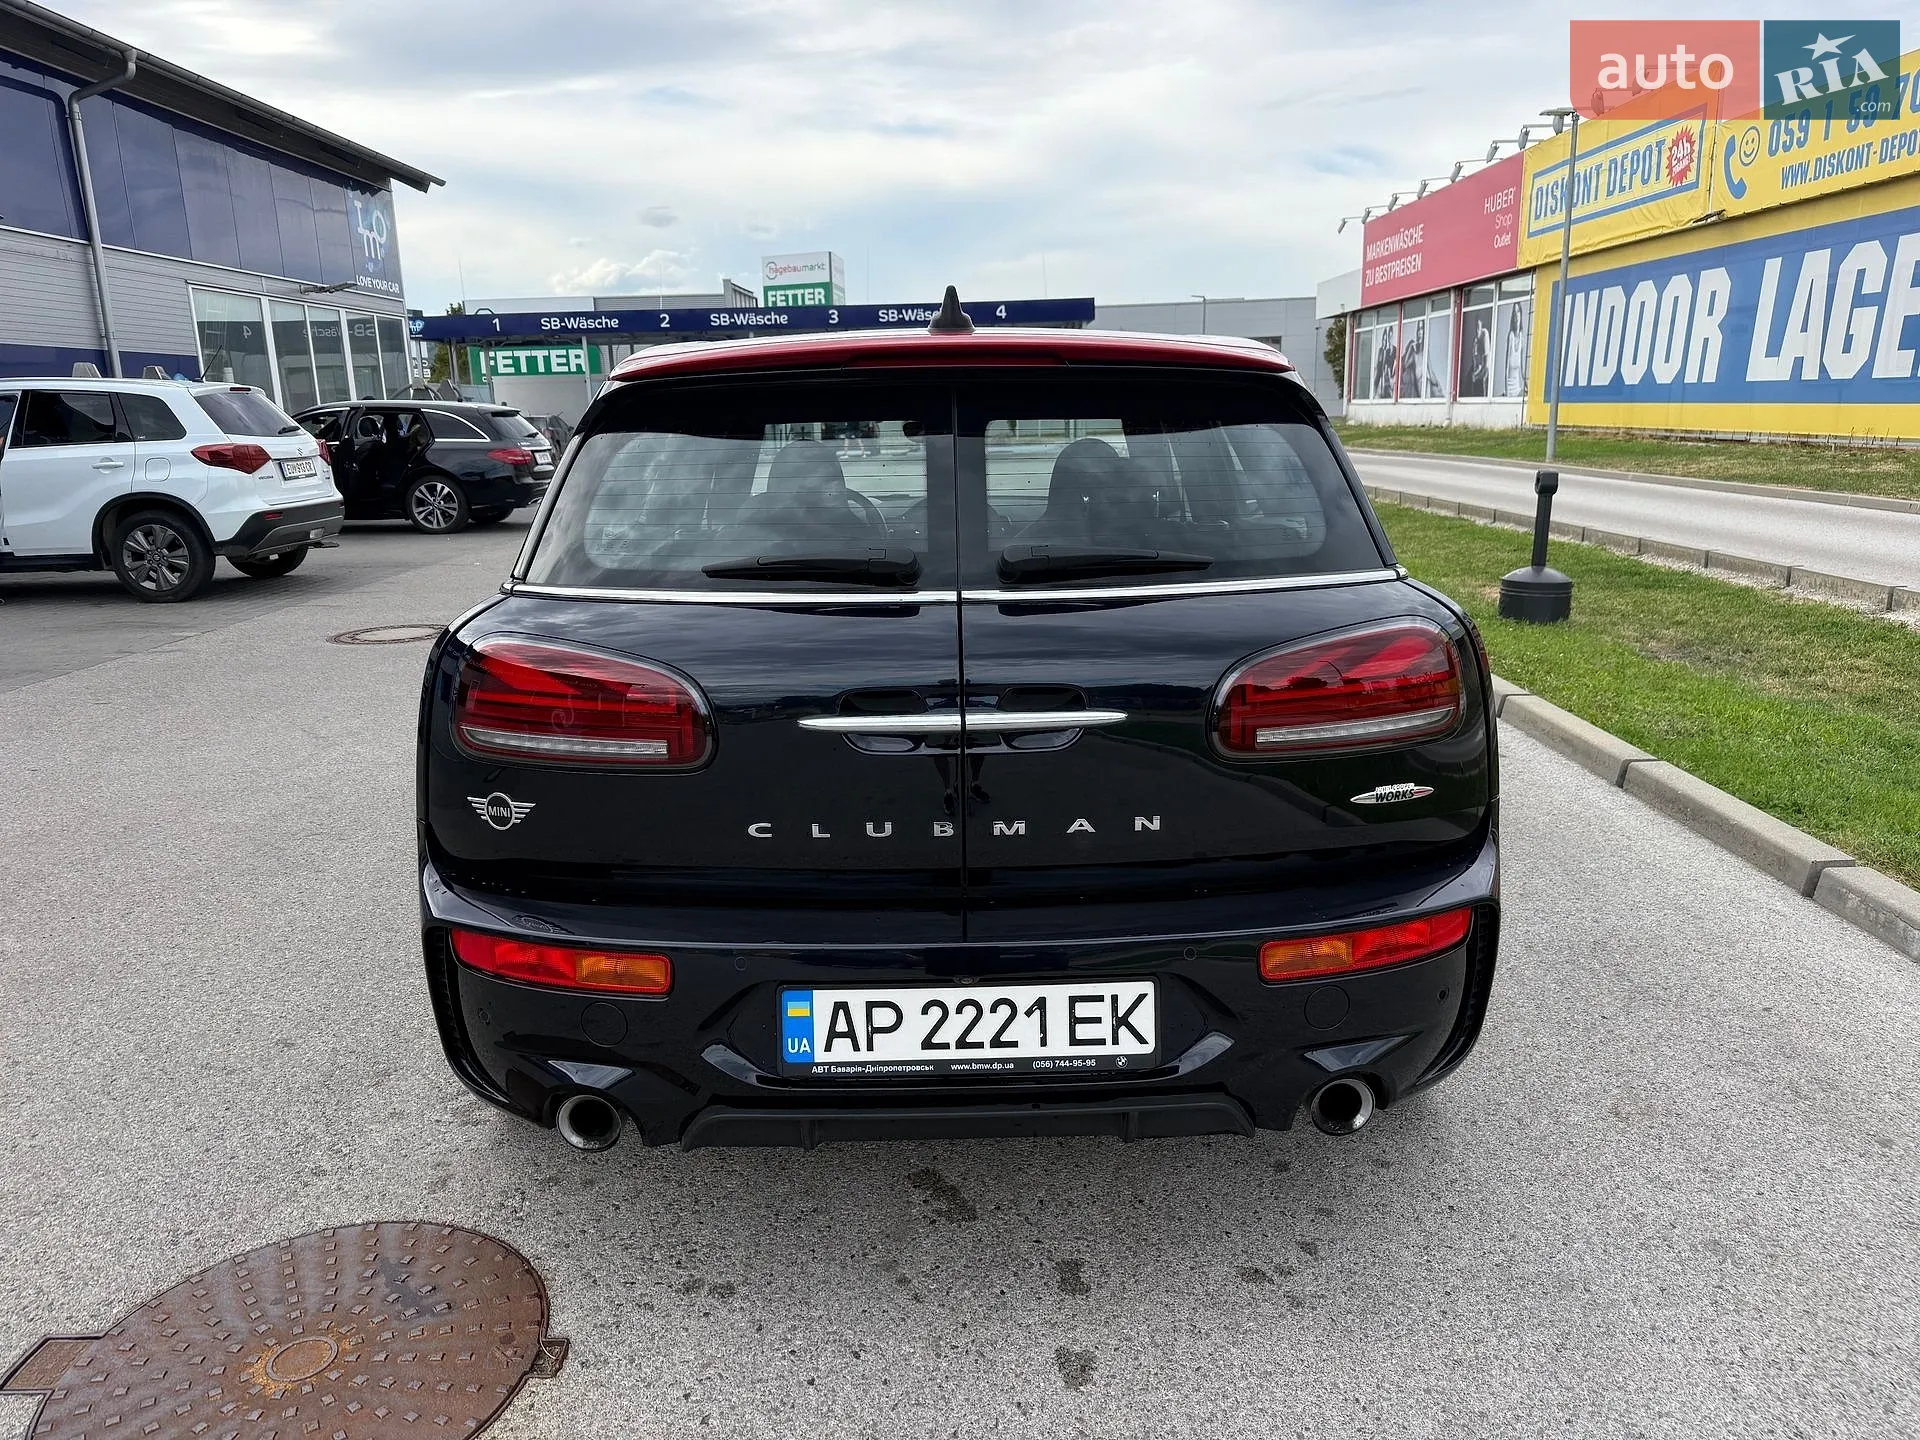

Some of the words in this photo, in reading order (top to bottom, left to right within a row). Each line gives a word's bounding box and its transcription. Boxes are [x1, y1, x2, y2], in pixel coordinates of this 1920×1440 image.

[1767, 108, 1811, 158] 059
[1823, 100, 1835, 142] 1
[1781, 128, 1920, 190] WWW.DISKONT-DEPO
[1534, 162, 1603, 220] DISKONT
[1606, 138, 1666, 197] DEPOT
[1495, 214, 1513, 230] Shop
[1366, 224, 1424, 262] MARKENWÄSCHE
[1494, 235, 1511, 248] Outlet
[768, 262, 826, 276] hagebaumarkt
[1365, 268, 1374, 288] ZU
[1375, 252, 1422, 284] BESTPREISEN
[356, 274, 372, 288] LOVE
[372, 277, 388, 291] YOUR
[388, 281, 400, 294] CAR
[767, 287, 825, 307] FETTER
[1745, 232, 1920, 383] LAGE
[492, 317, 501, 332] 1
[541, 315, 619, 330] SB-Wäsche
[659, 314, 671, 328] 2
[710, 310, 788, 326] SB-Wäsche
[828, 309, 839, 324] 3
[878, 308, 940, 322] SB-Wäs
[995, 304, 1007, 319] 4
[479, 349, 587, 374] FETTER
[1376, 788, 1415, 802] WORKS
[488, 805, 511, 818] MINI
[747, 815, 1160, 838] CLUBMAN
[823, 1000, 903, 1053] AP
[920, 996, 1047, 1051] 2221
[1068, 992, 1149, 1048] EK
[787, 1036, 811, 1054] UA
[831, 1064, 934, 1074] Баварія-Дніпропетровськ
[950, 1061, 1014, 1071] www.bmw.dp.ua
[1032, 1060, 1053, 1069] (056)
[1055, 1059, 1096, 1068] 744-95-95
